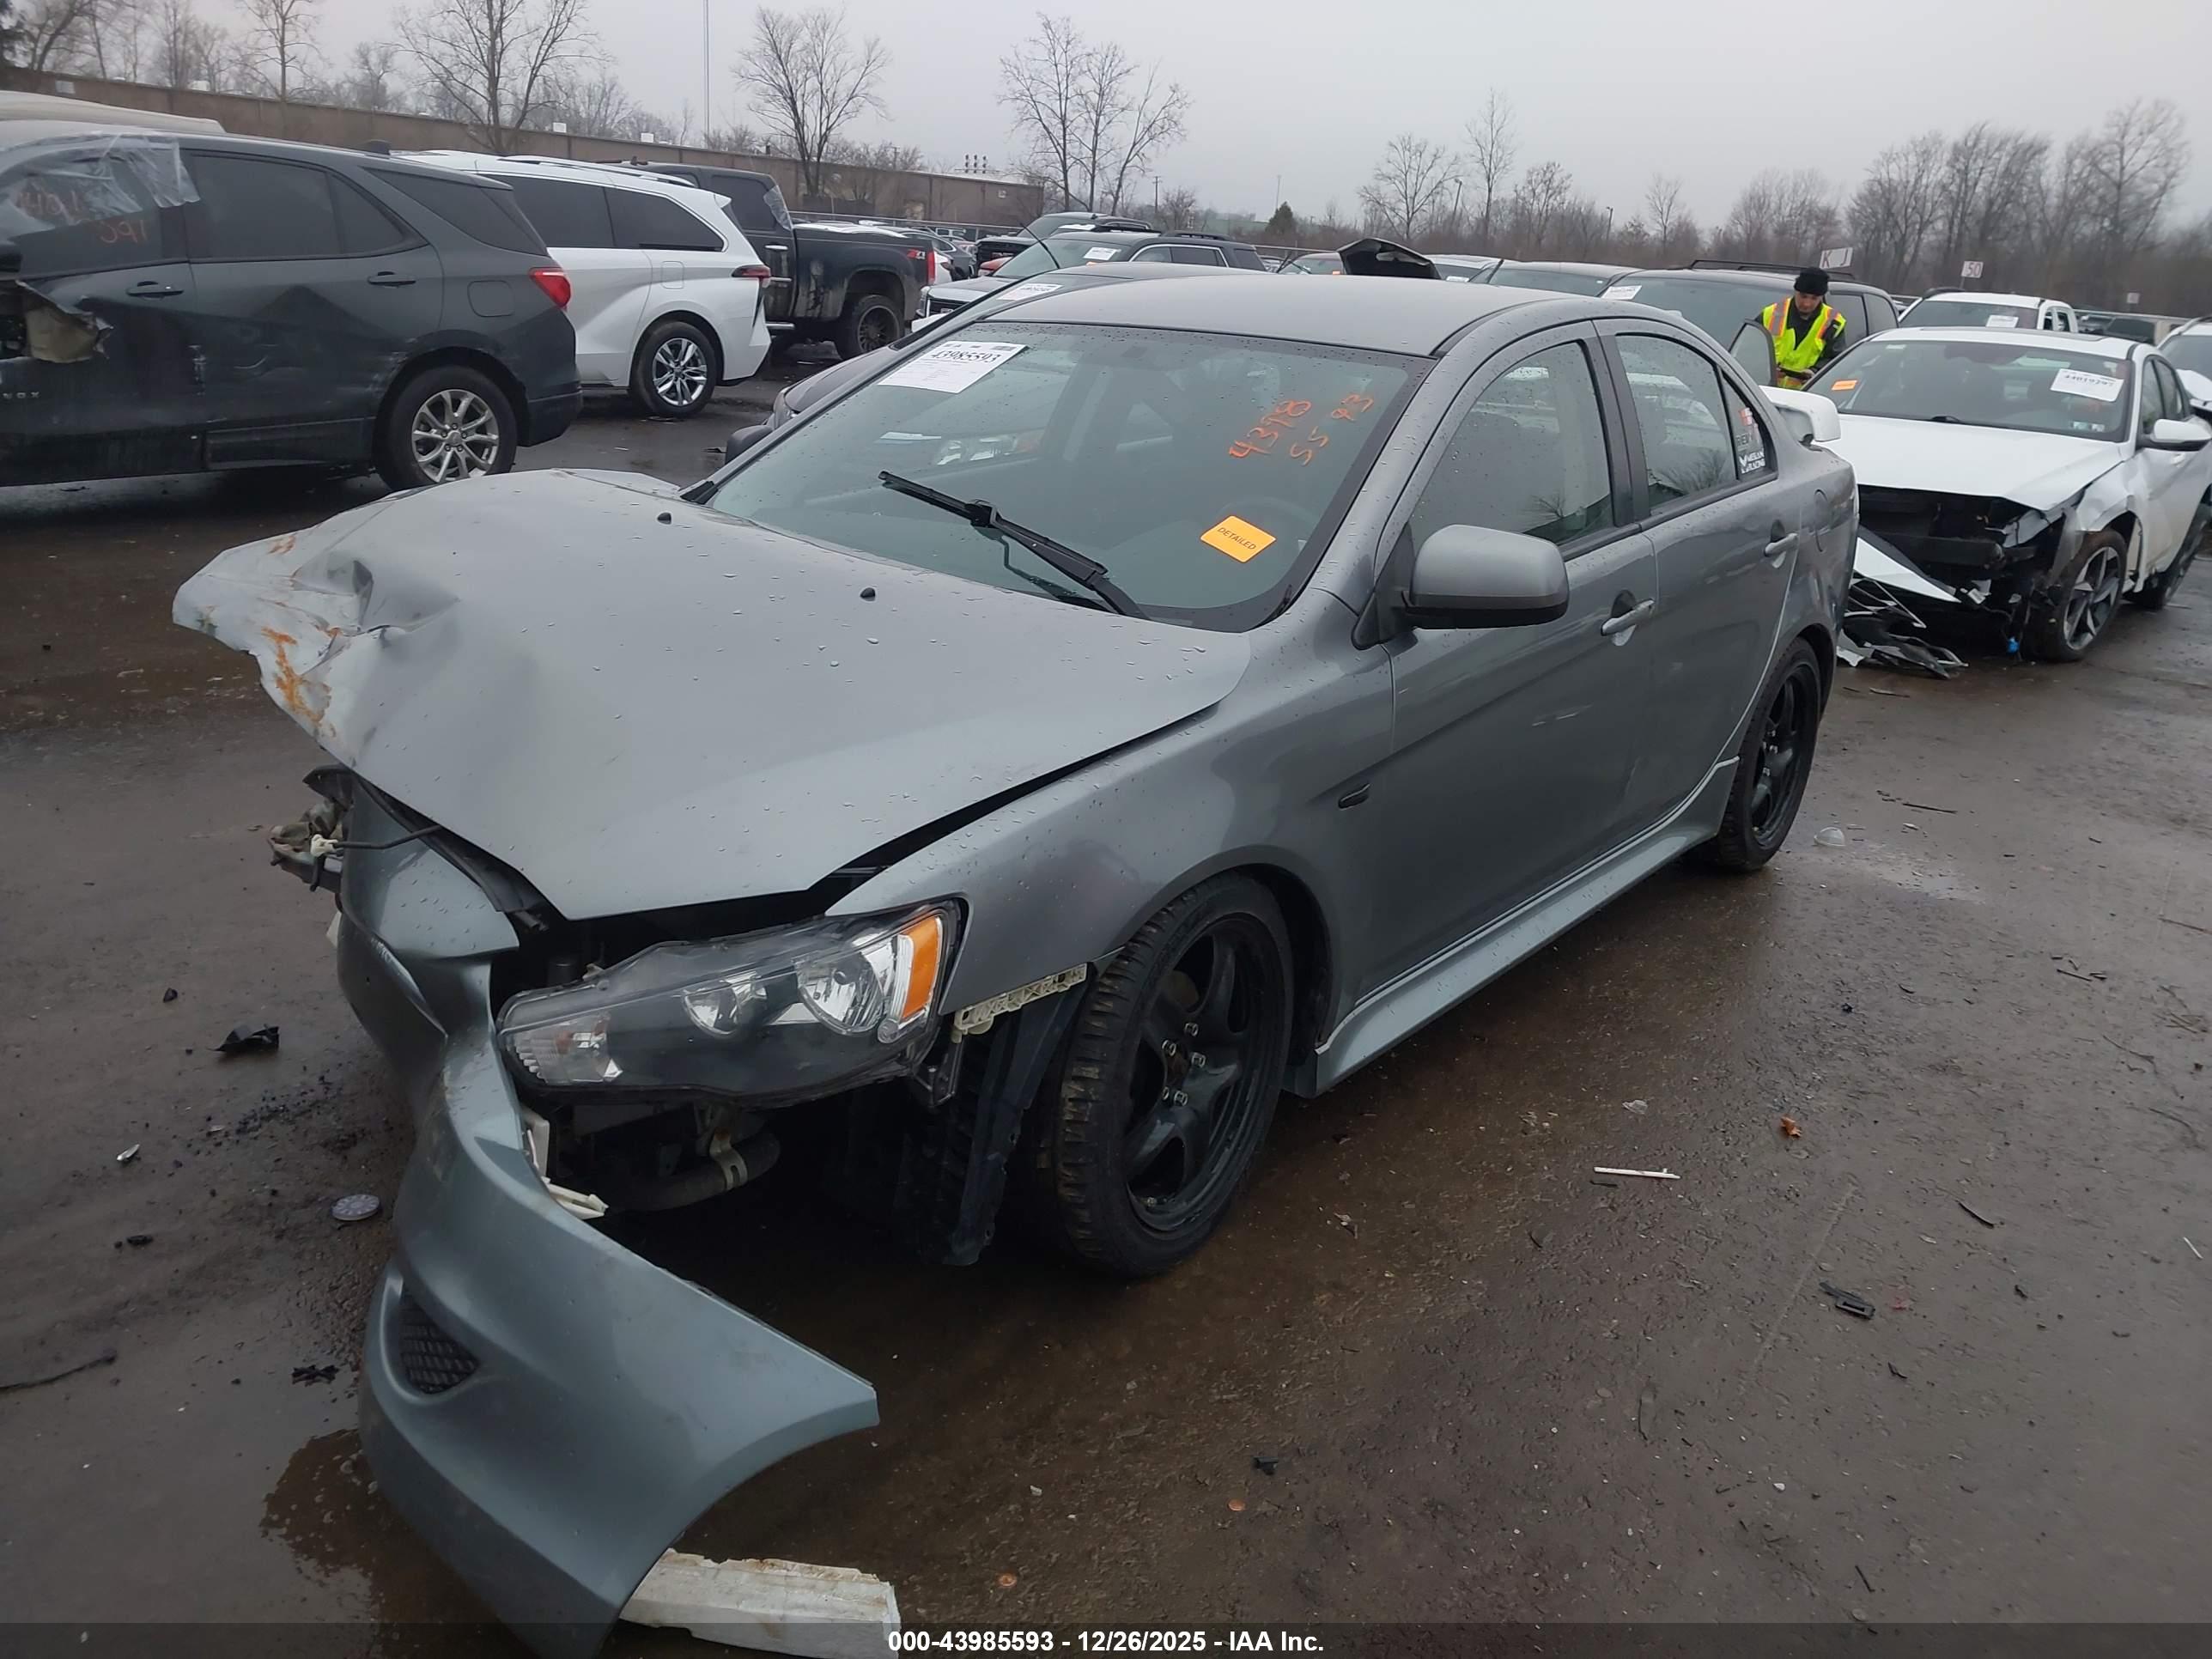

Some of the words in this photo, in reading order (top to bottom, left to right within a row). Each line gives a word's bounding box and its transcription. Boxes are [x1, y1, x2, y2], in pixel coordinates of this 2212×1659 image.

[1821, 250, 1832, 269] K
[931, 350, 1002, 363] 43985593
[1217, 526, 1257, 550] DETAILED
